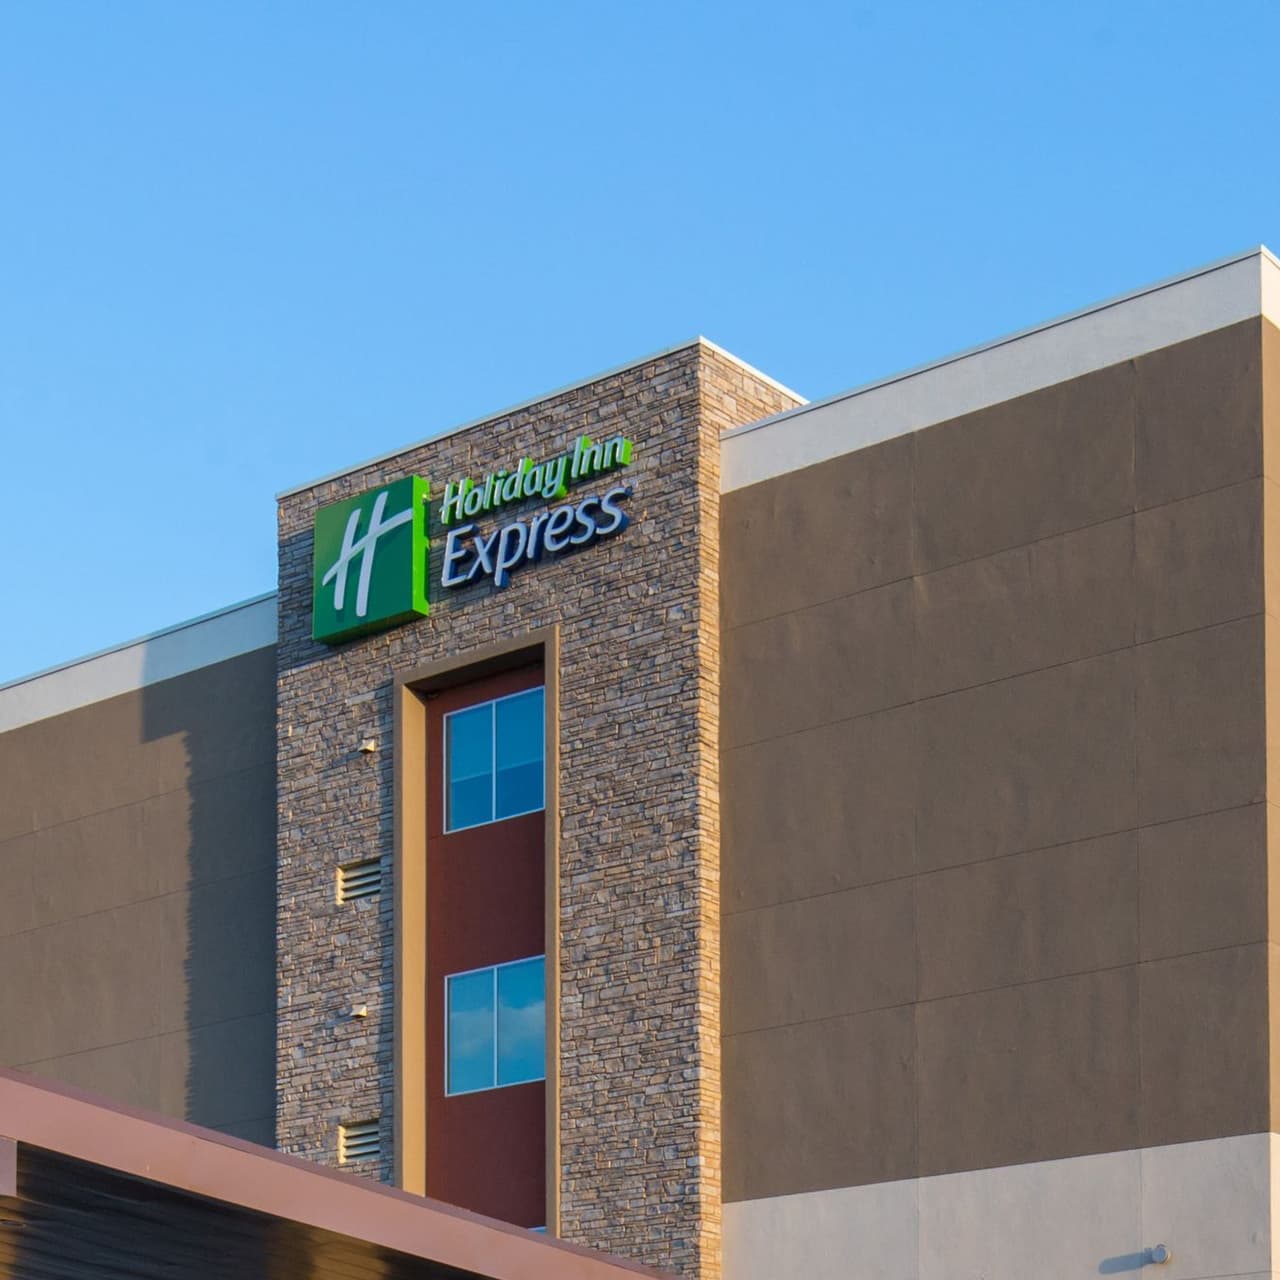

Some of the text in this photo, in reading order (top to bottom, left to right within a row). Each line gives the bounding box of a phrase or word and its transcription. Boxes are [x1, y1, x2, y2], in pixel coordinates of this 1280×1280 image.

[439, 435, 631, 525] Holiday Inn
[441, 486, 629, 588] Express
